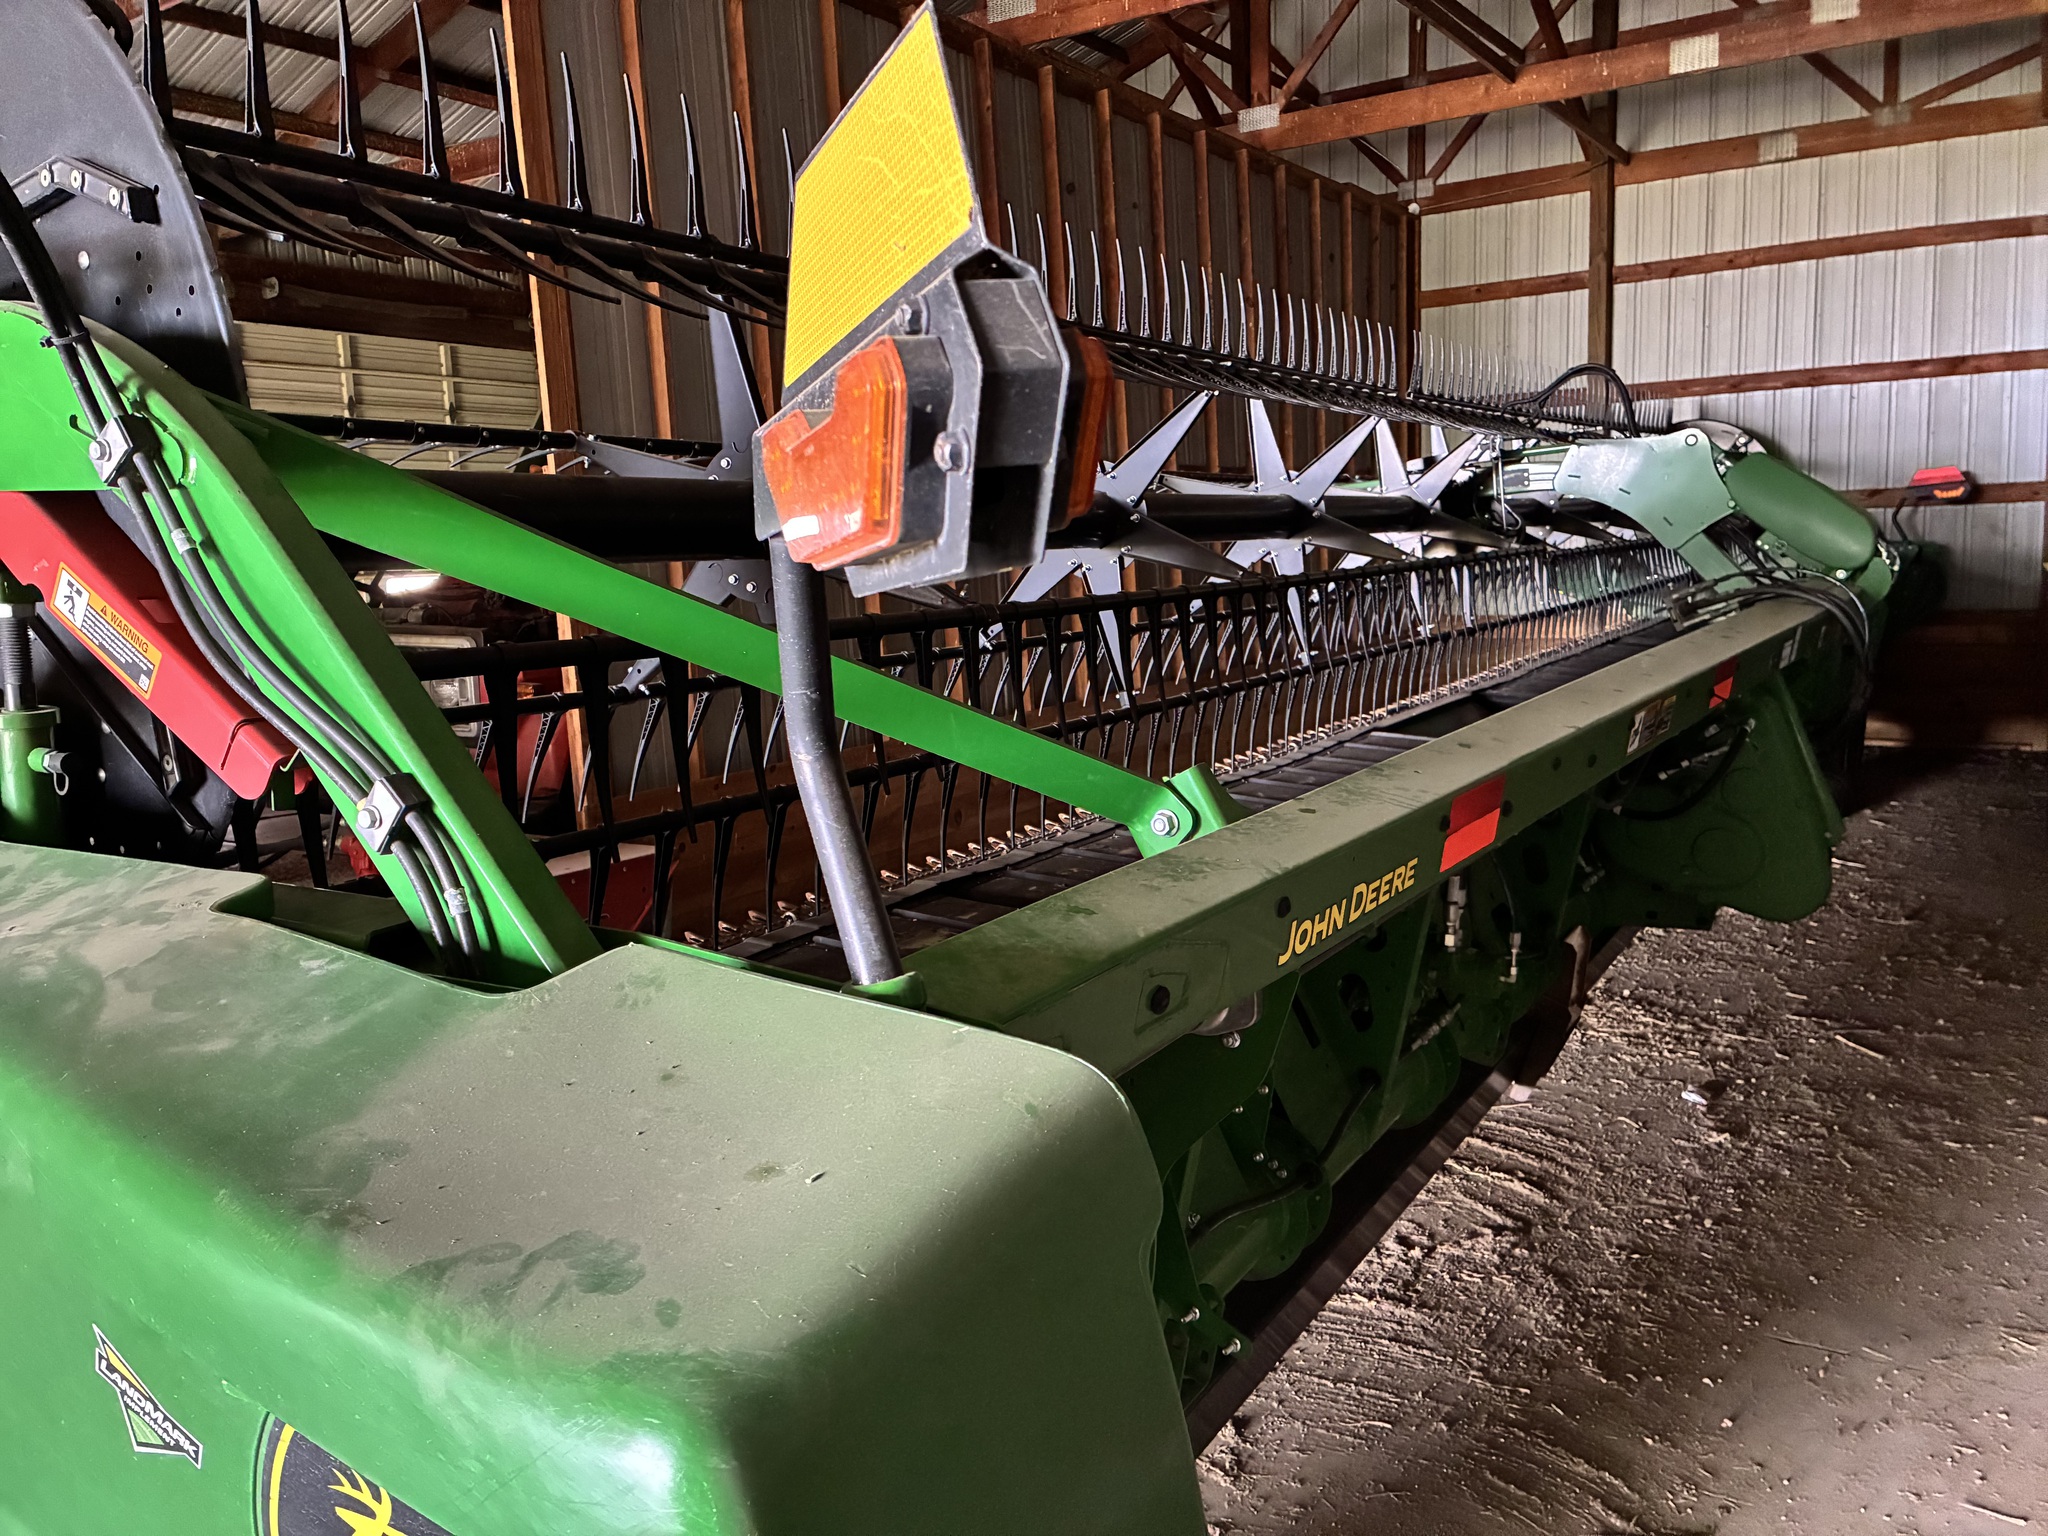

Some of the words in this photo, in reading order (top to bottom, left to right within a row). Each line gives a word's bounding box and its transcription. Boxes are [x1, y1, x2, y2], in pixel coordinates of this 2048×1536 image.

[110, 612, 149, 654] WARNING
[1277, 898, 1347, 966] JOHN
[1348, 857, 1419, 923] DEERE
[99, 1358, 198, 1459] LANDMARK
[123, 1395, 177, 1447] IMPLEMENT
